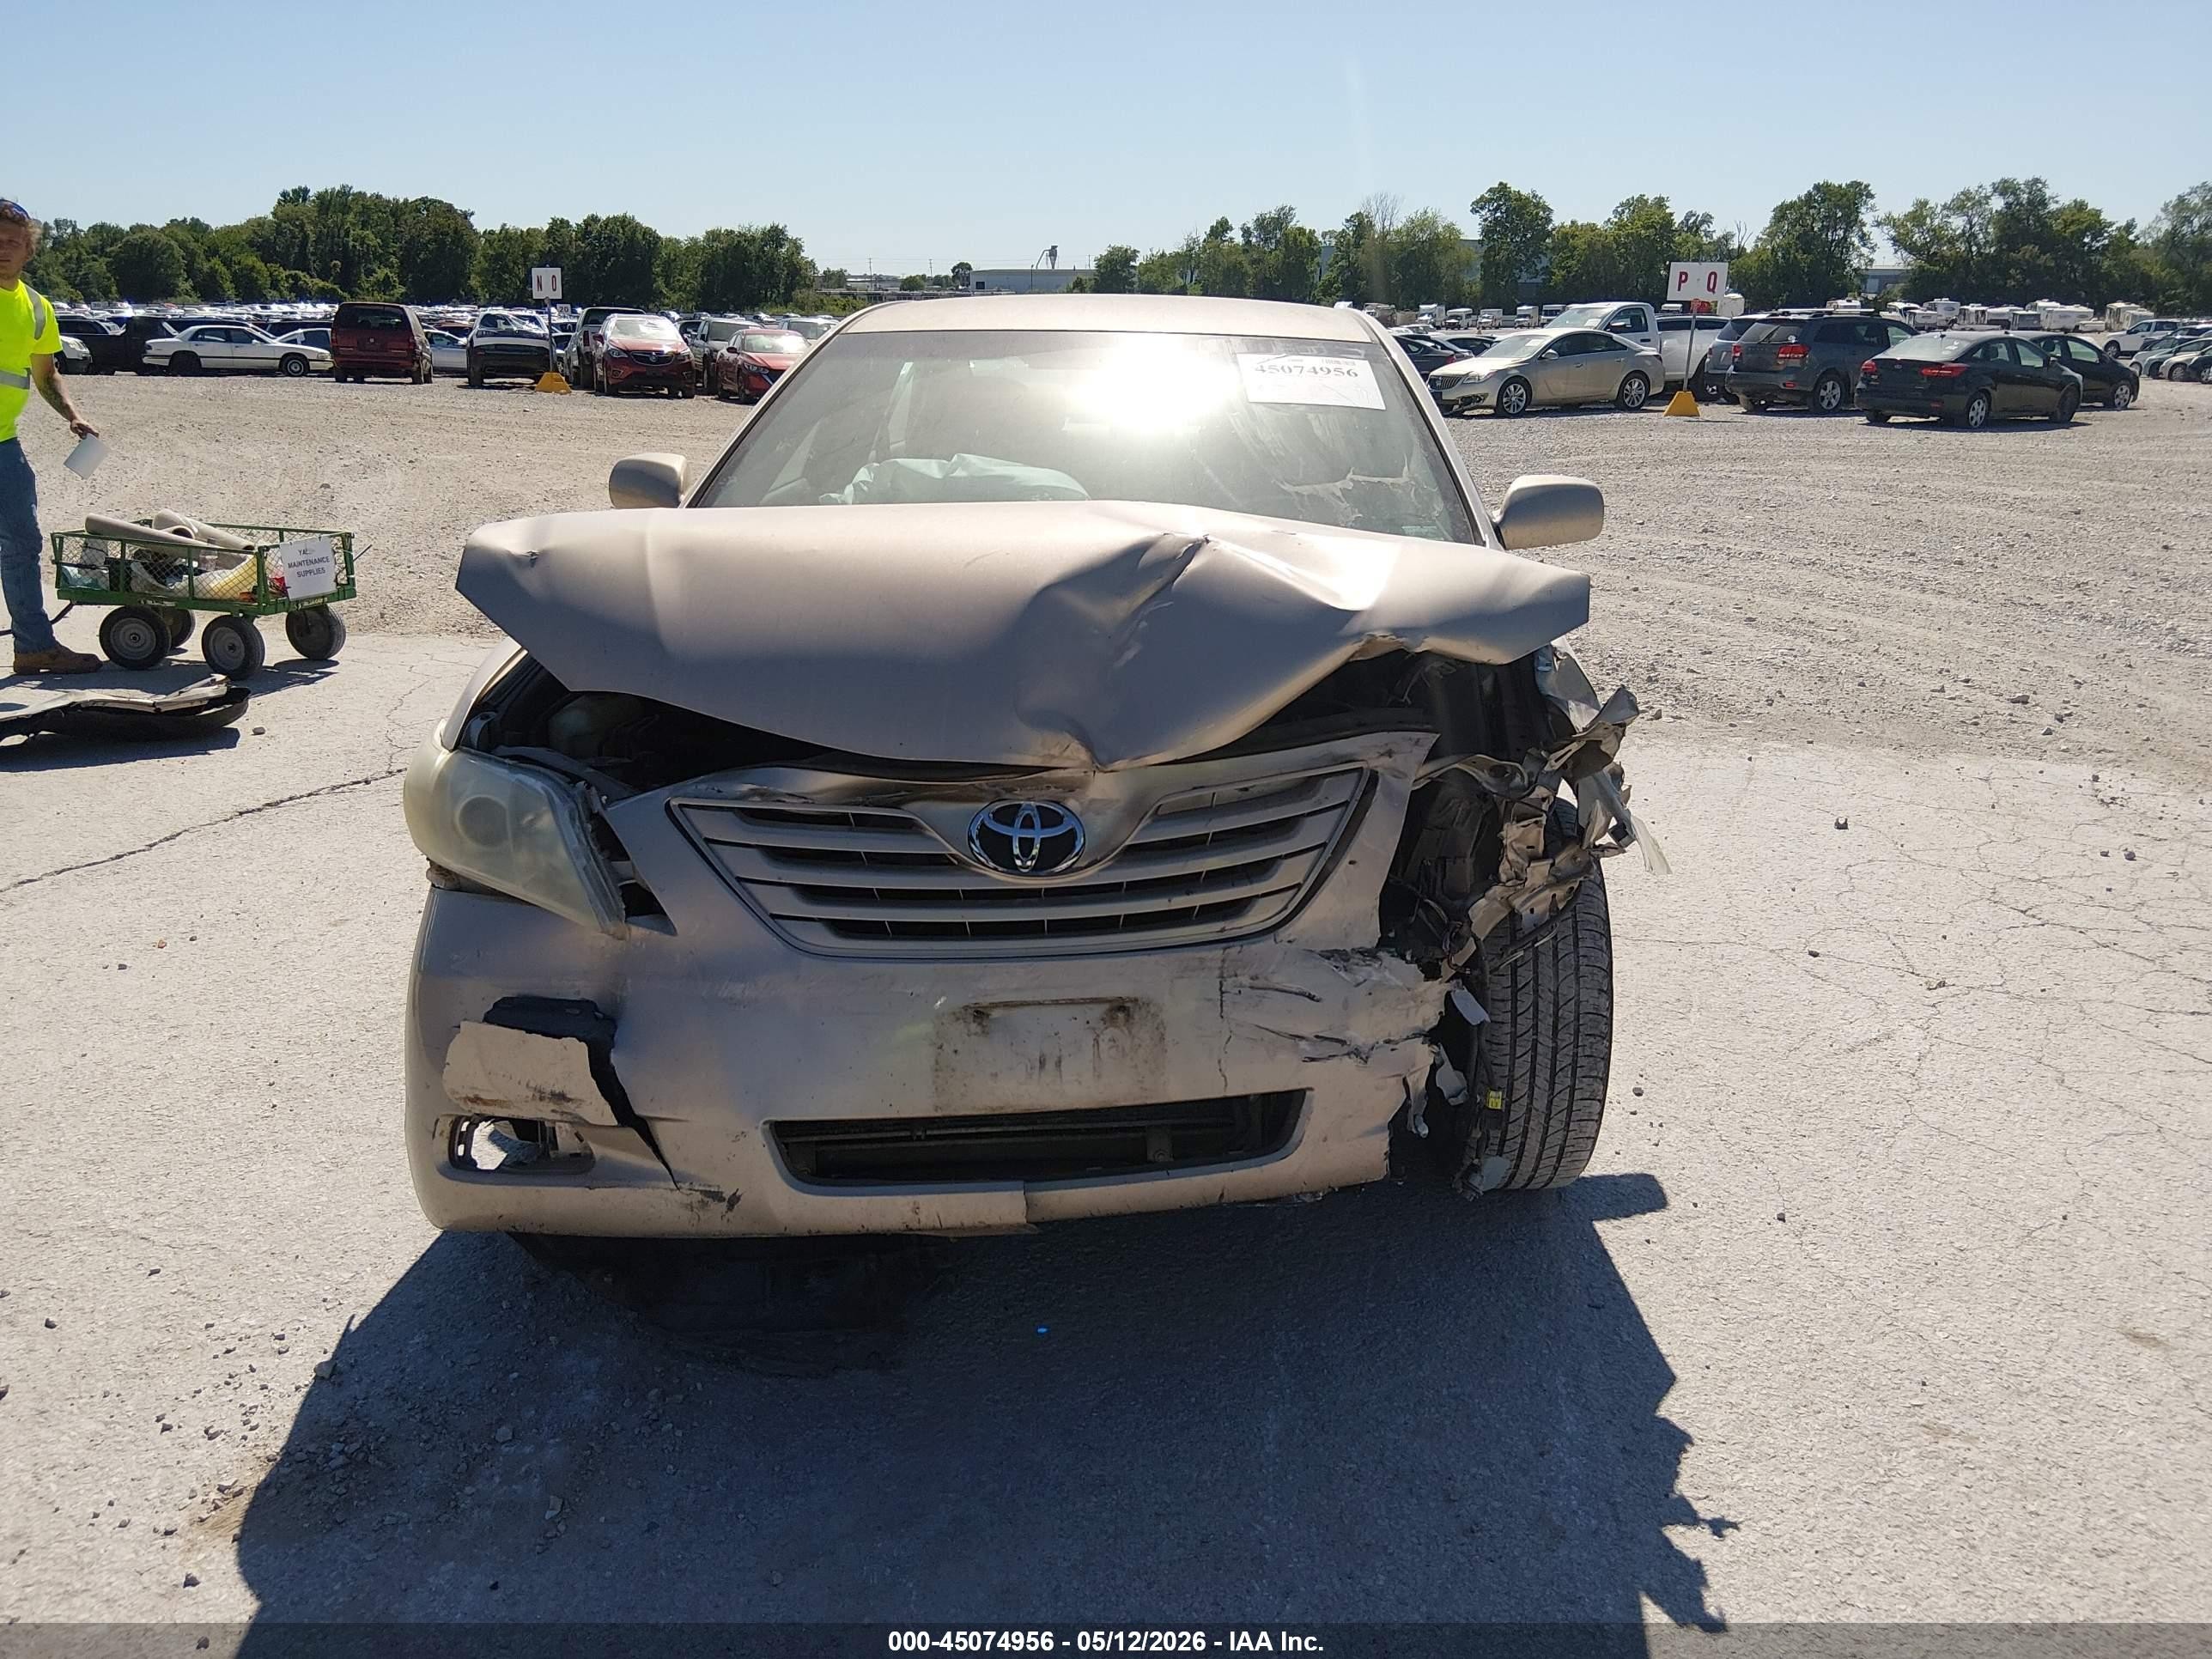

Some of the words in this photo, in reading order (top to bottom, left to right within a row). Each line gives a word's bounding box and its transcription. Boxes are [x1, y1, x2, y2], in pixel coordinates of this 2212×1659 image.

[537, 275, 543, 291] N
[1677, 271, 1688, 291] P
[1706, 271, 1717, 293] Q
[1255, 364, 1358, 378] 45074956
[288, 556, 330, 568] MAINTENANCE
[296, 568, 326, 577] SUPPLIES
